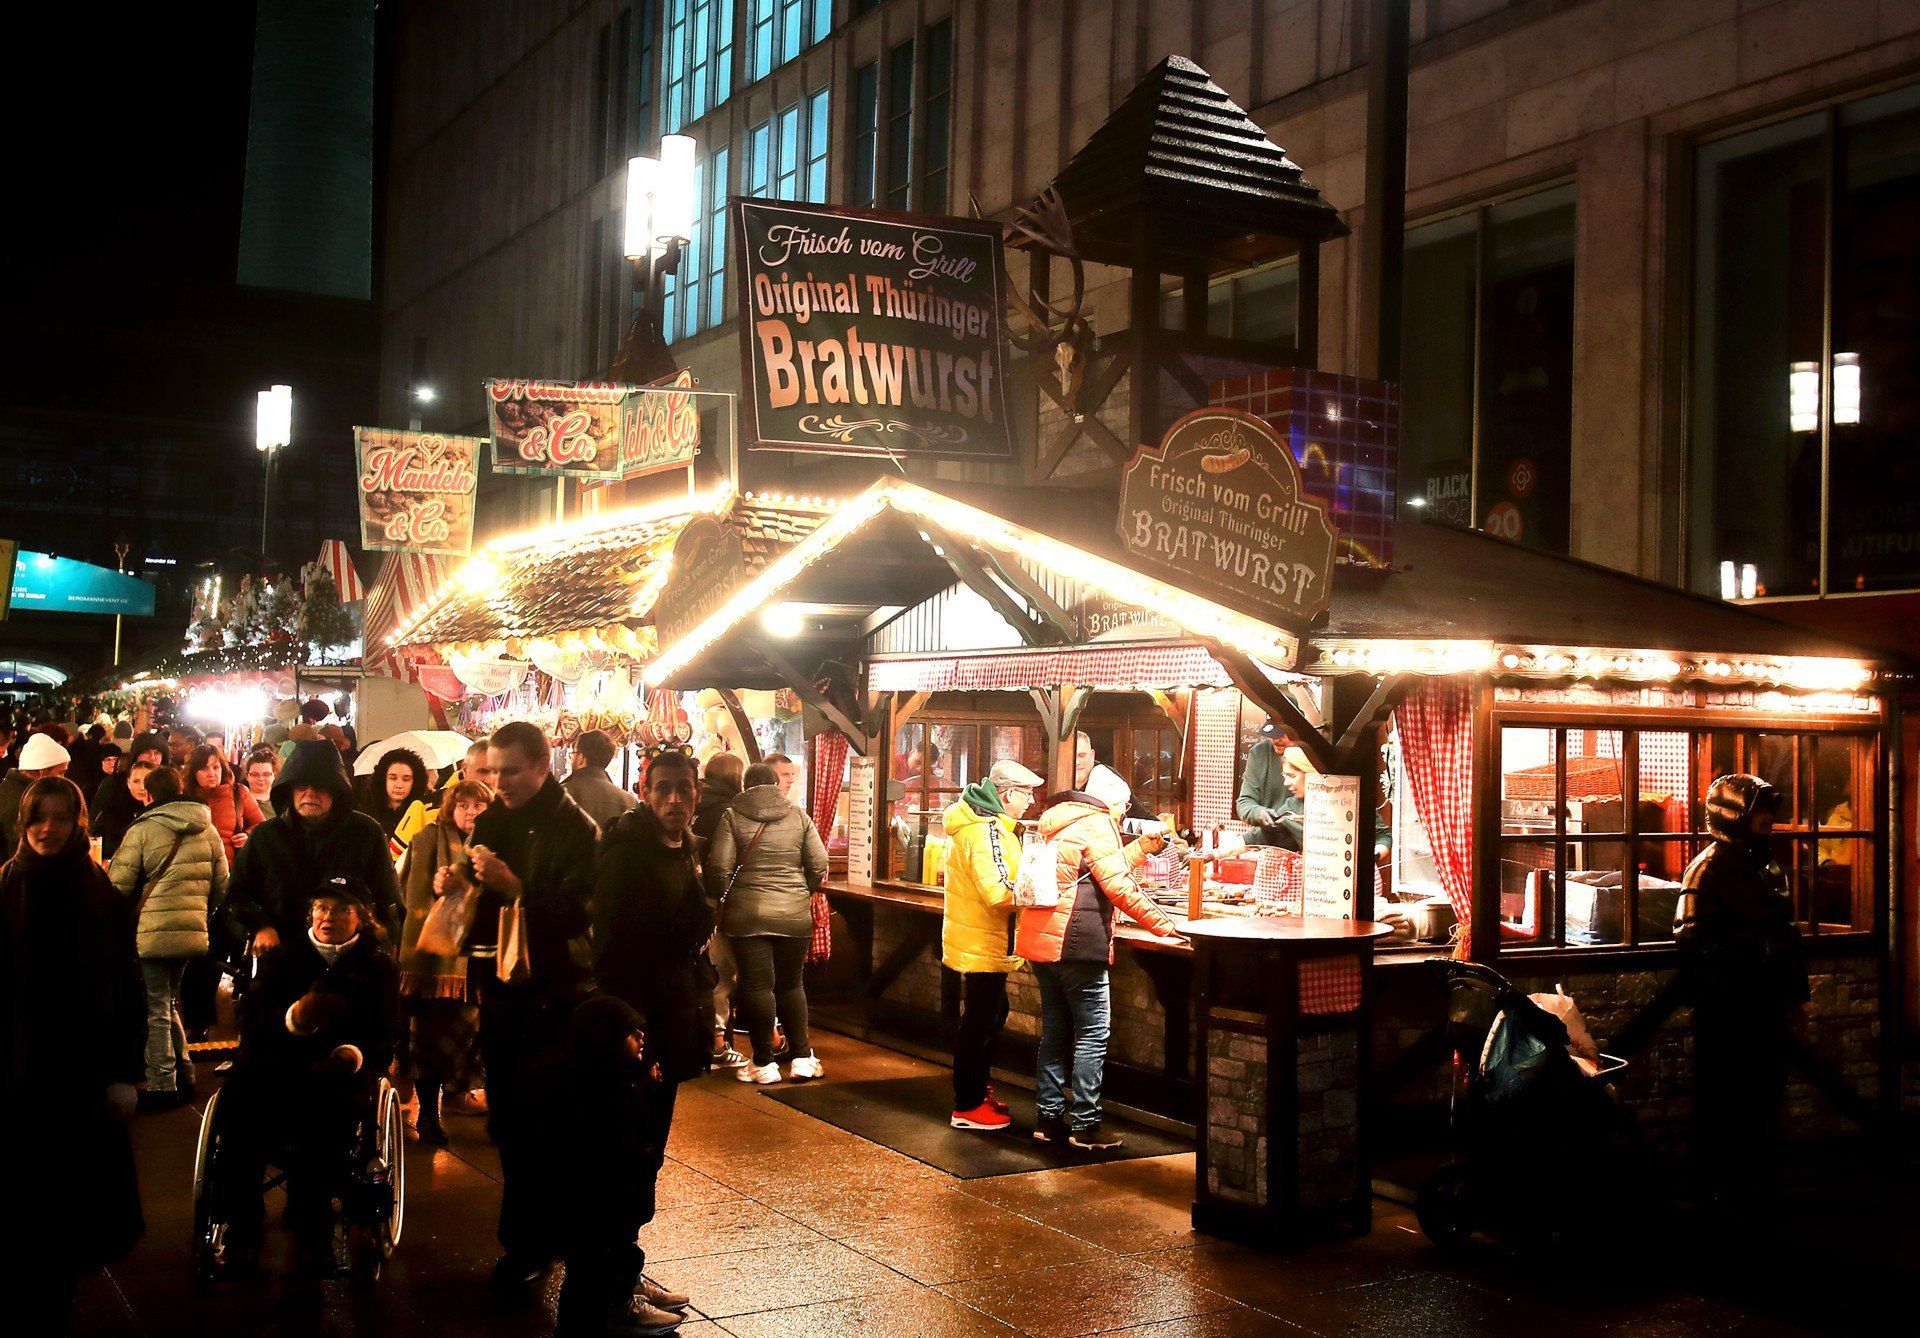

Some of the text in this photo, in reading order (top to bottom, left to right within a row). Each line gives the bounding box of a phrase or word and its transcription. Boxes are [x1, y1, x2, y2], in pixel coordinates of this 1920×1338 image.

[759, 224, 977, 284] Frisch vom Grill
[754, 272, 991, 341] Original Thüringer
[756, 319, 993, 424] Bratwurst
[519, 410, 597, 465] & Co.
[360, 447, 477, 493] Mandeln
[1427, 473, 1469, 500] BLACK
[384, 500, 449, 543] & Co.
[1150, 464, 1309, 536] Frisch vom Grill!
[1162, 496, 1286, 551] Original Thüringer
[1132, 509, 1316, 605] BRATWURST
